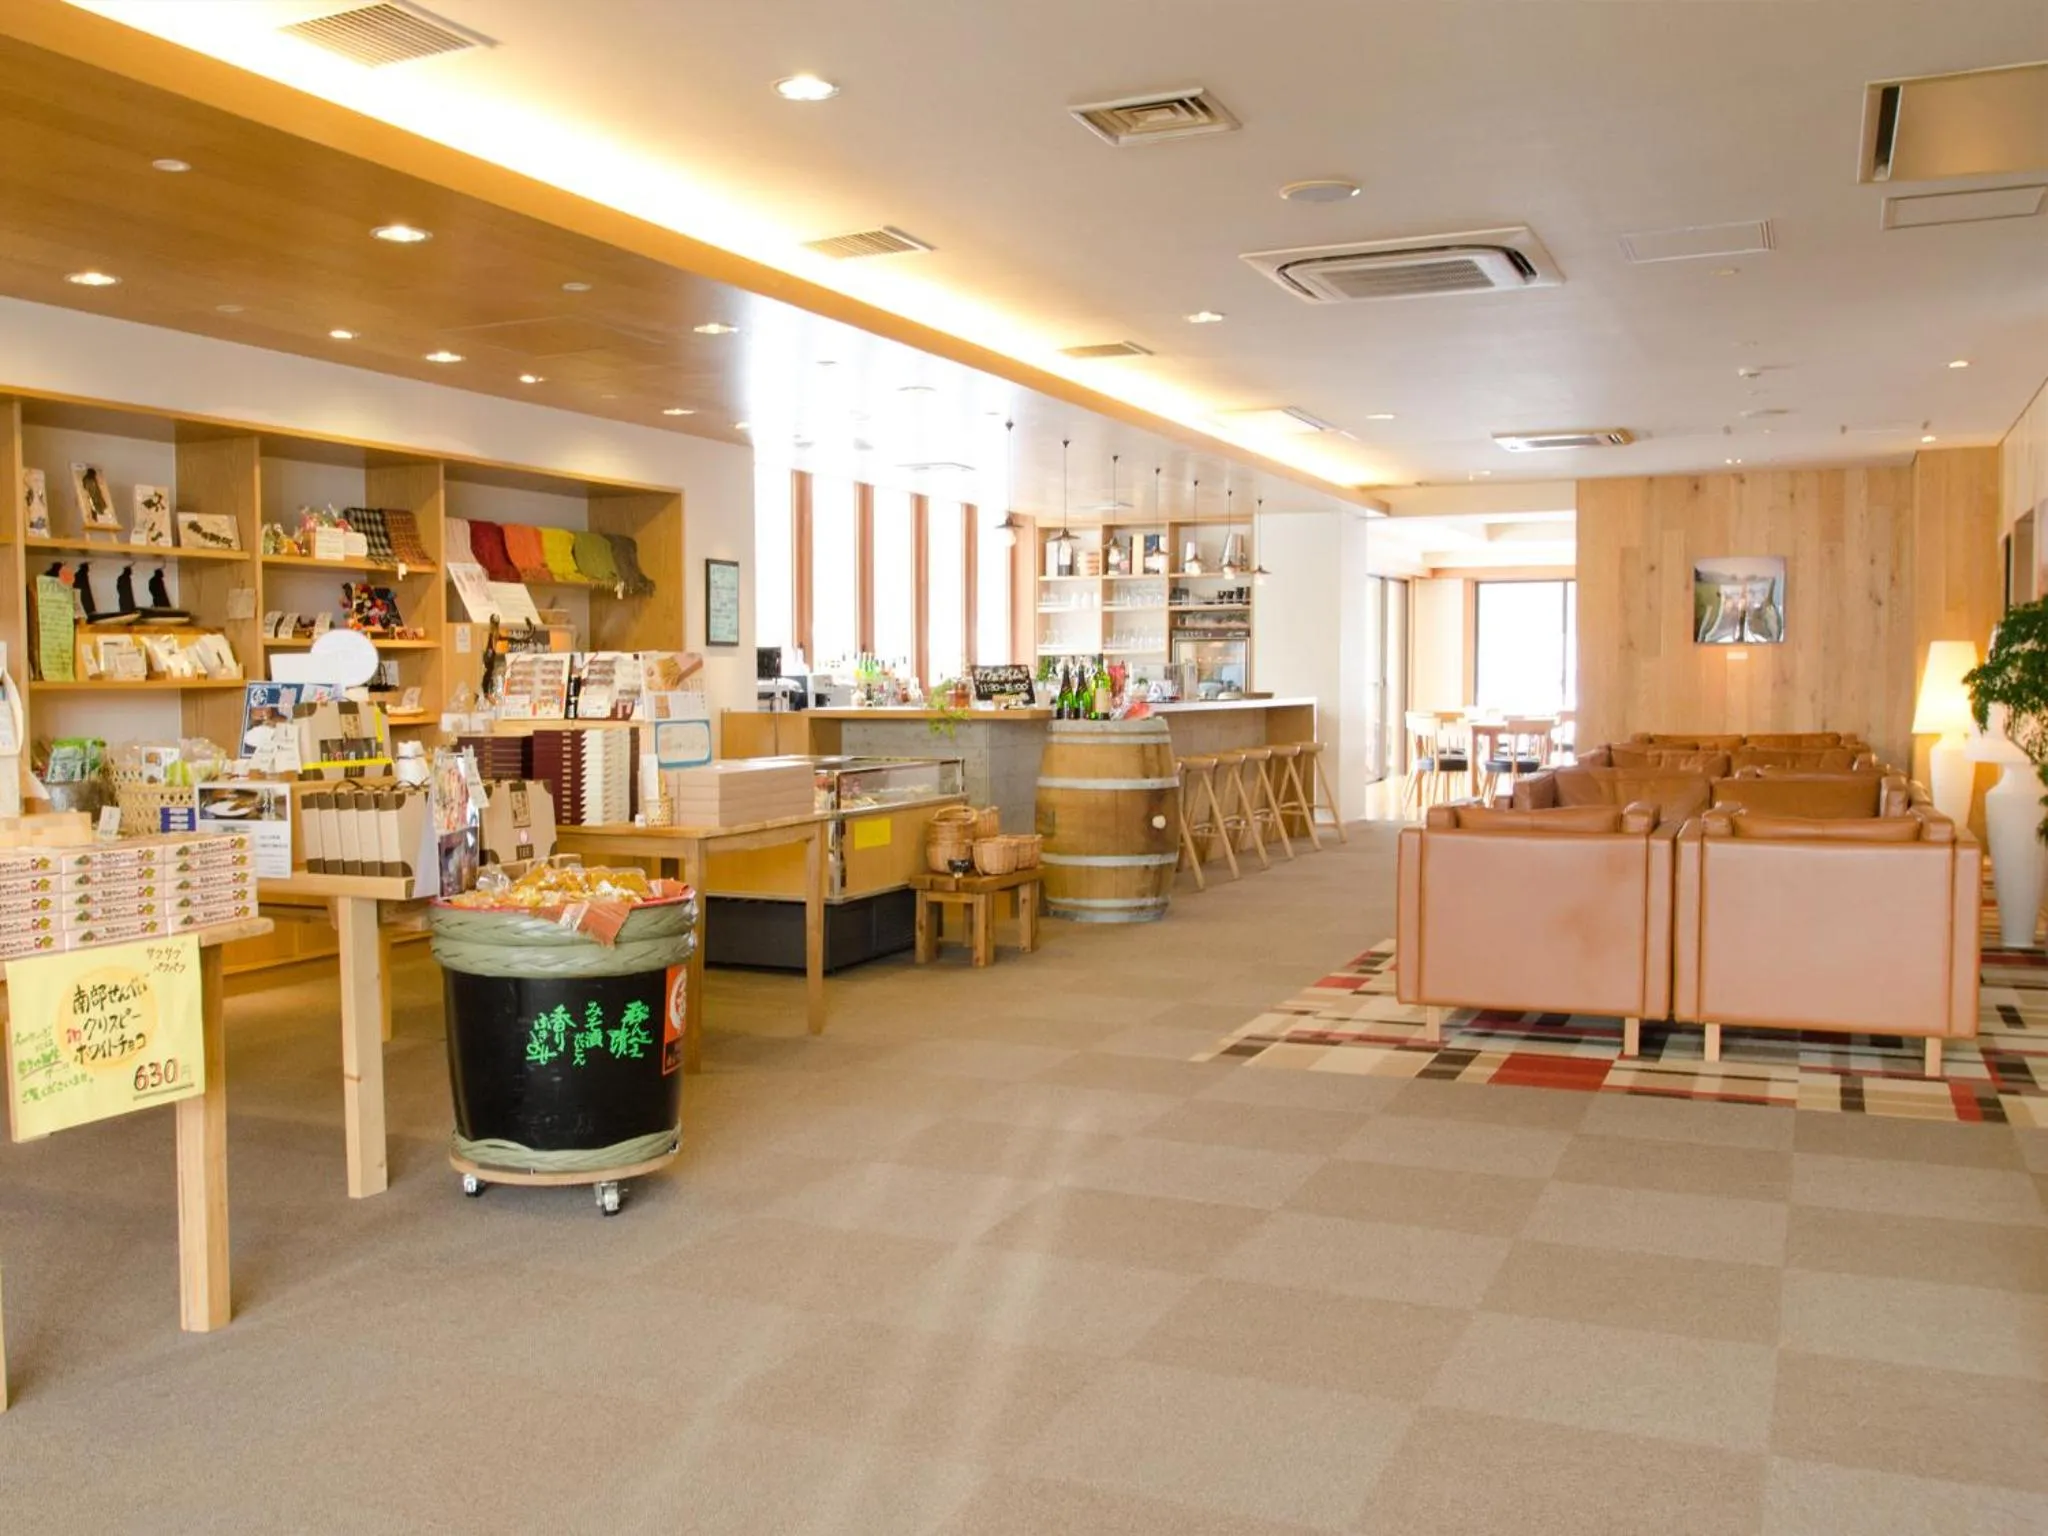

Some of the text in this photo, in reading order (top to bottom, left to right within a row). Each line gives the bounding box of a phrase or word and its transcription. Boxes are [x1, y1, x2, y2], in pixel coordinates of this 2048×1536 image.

[73, 1032, 148, 1065] ホワイトチョコ
